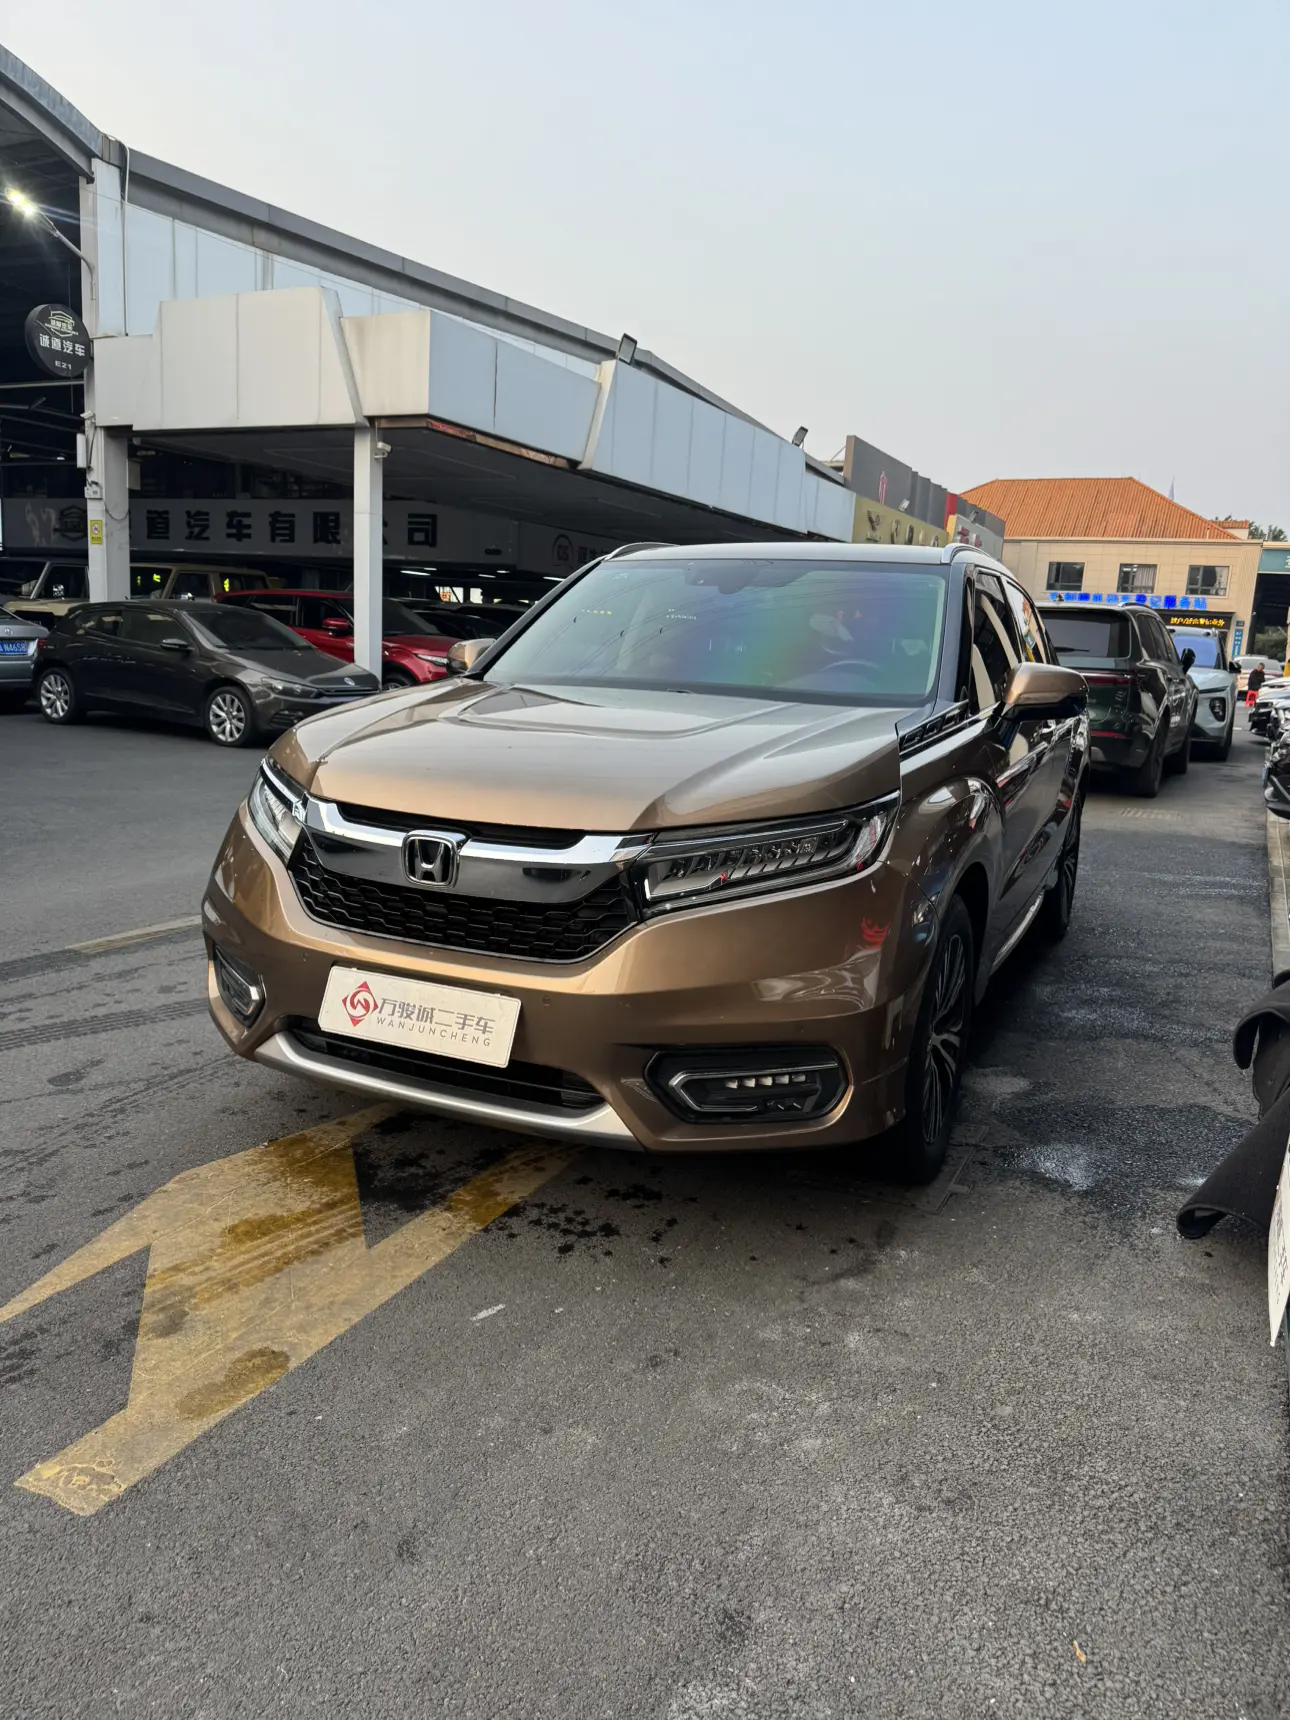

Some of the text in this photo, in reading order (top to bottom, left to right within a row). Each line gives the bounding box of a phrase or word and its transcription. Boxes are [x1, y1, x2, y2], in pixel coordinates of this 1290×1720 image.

[55, 361, 72, 370] E21
[129, 510, 438, 548] 道汽车有限司
[376, 1016, 492, 1047] WANJUNCHENG
[377, 997, 496, 1035] 万骏诚二手车
